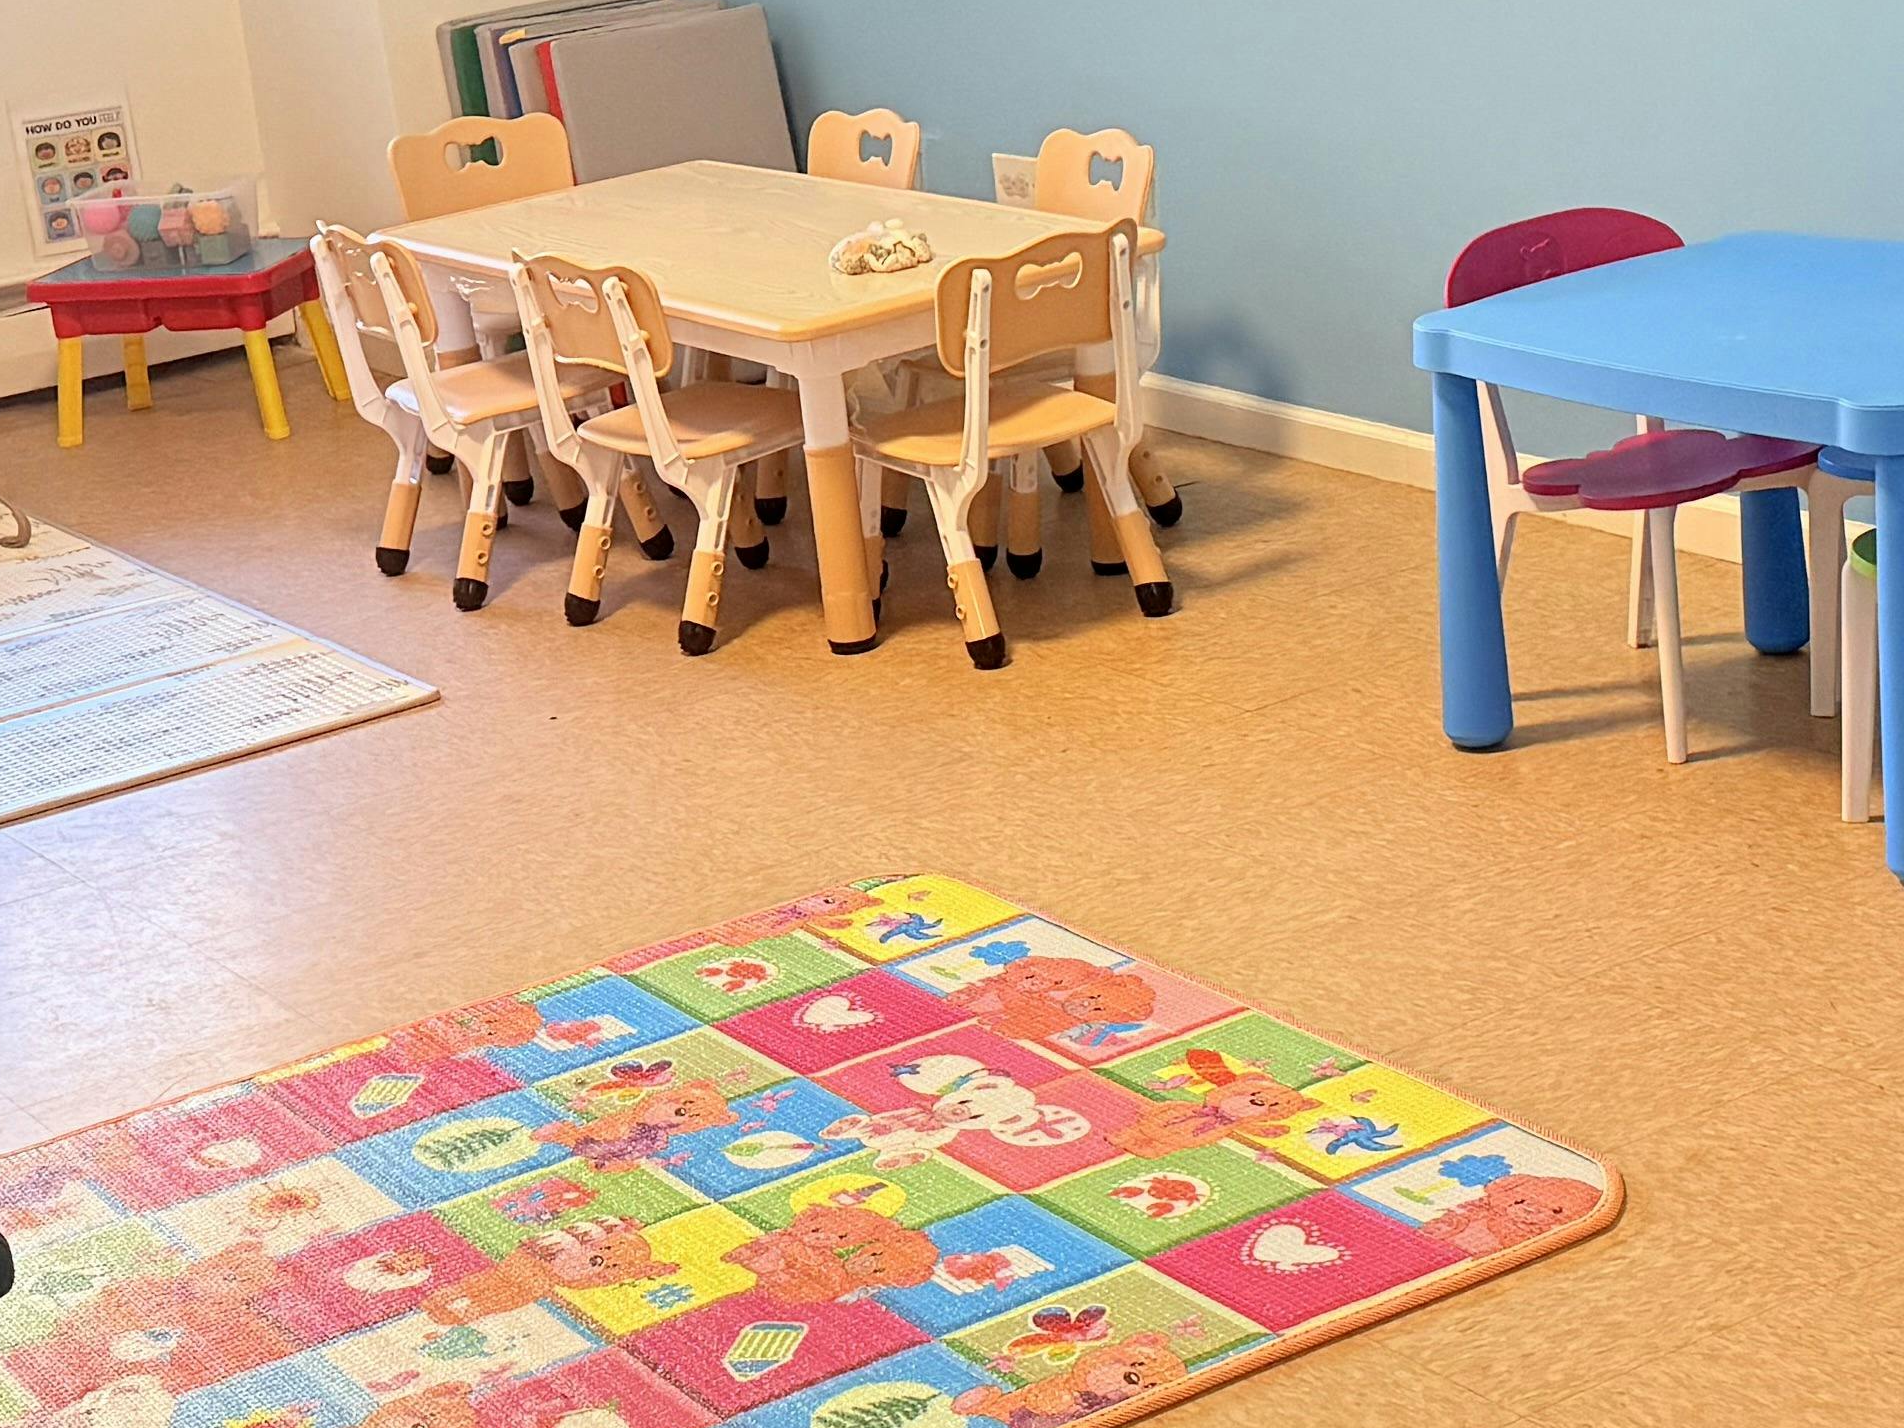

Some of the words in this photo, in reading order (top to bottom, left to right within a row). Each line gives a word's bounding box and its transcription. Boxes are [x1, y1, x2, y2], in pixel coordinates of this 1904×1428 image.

[25, 123, 52, 135] HOW
[56, 120, 72, 131] DO
[75, 115, 97, 128] YOU
